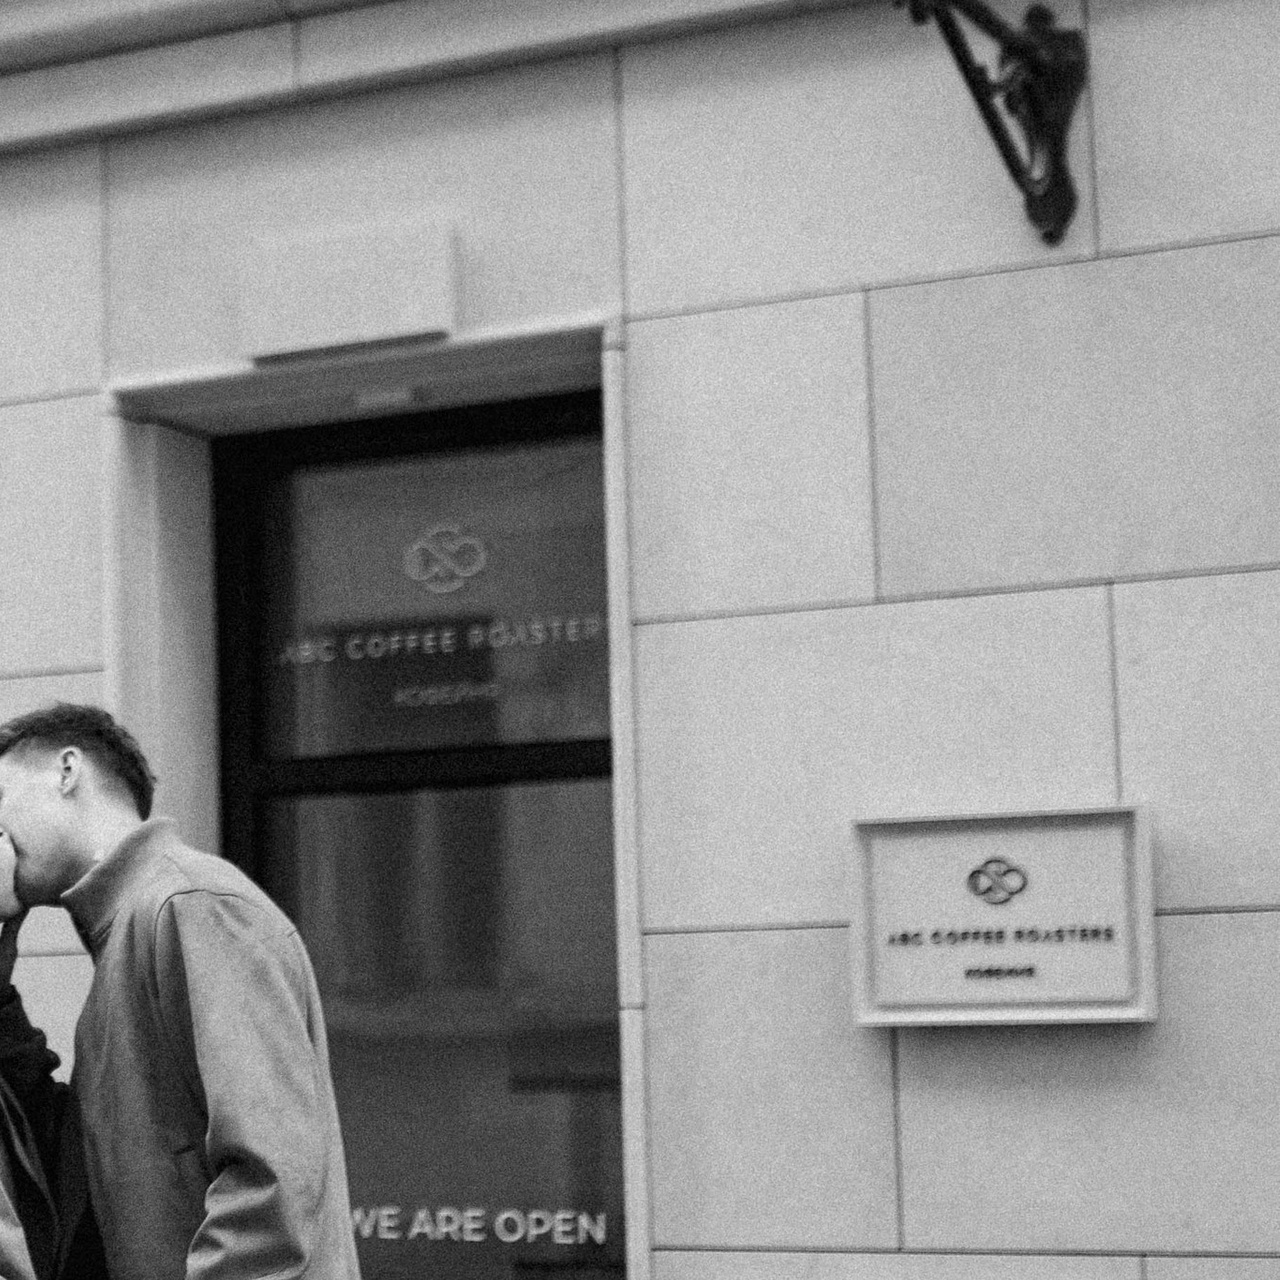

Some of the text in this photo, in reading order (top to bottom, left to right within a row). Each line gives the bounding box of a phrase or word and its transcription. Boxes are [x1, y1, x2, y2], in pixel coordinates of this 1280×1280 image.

[345, 629, 456, 660] COFFEE
[470, 616, 602, 649] ROASTER
[930, 928, 1005, 945] COFFEE
[1013, 925, 1115, 944] ROASTERS
[407, 1206, 487, 1242] ARE
[494, 1208, 607, 1245] OPEN
